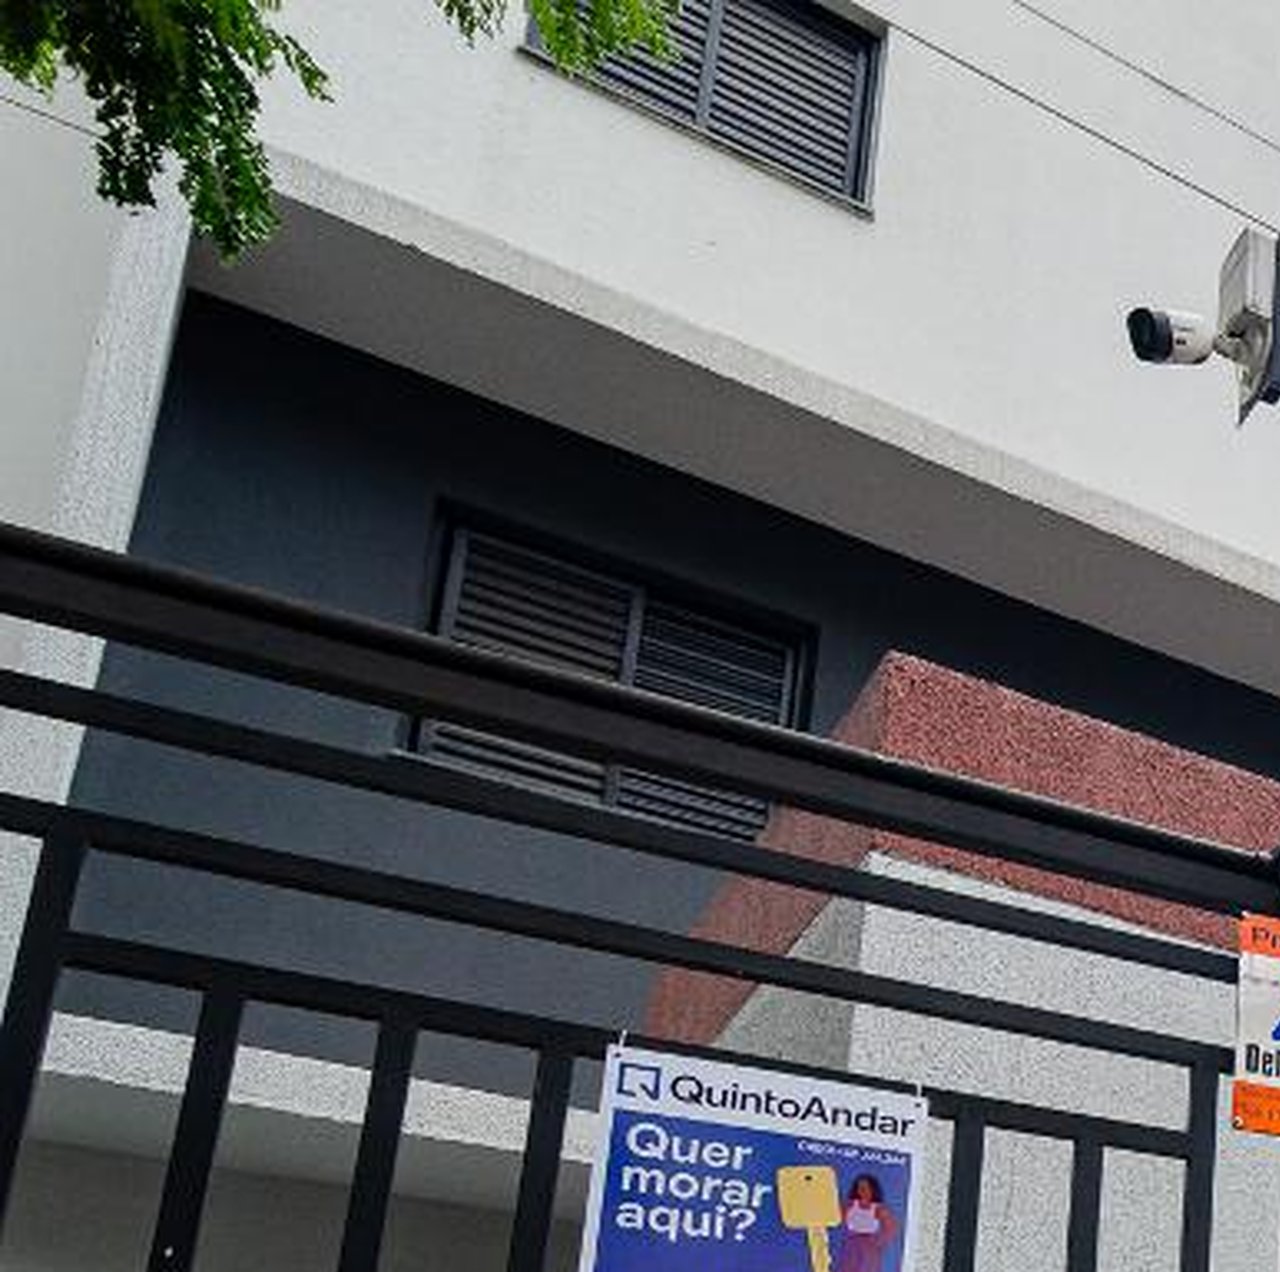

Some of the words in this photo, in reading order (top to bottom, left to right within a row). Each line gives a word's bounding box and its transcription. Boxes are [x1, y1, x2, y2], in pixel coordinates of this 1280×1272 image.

[671, 1076, 915, 1138] QuintoAndar
[626, 1122, 754, 1169] Quer
[621, 1165, 773, 1209] morar
[615, 1200, 757, 1242] aqui?
